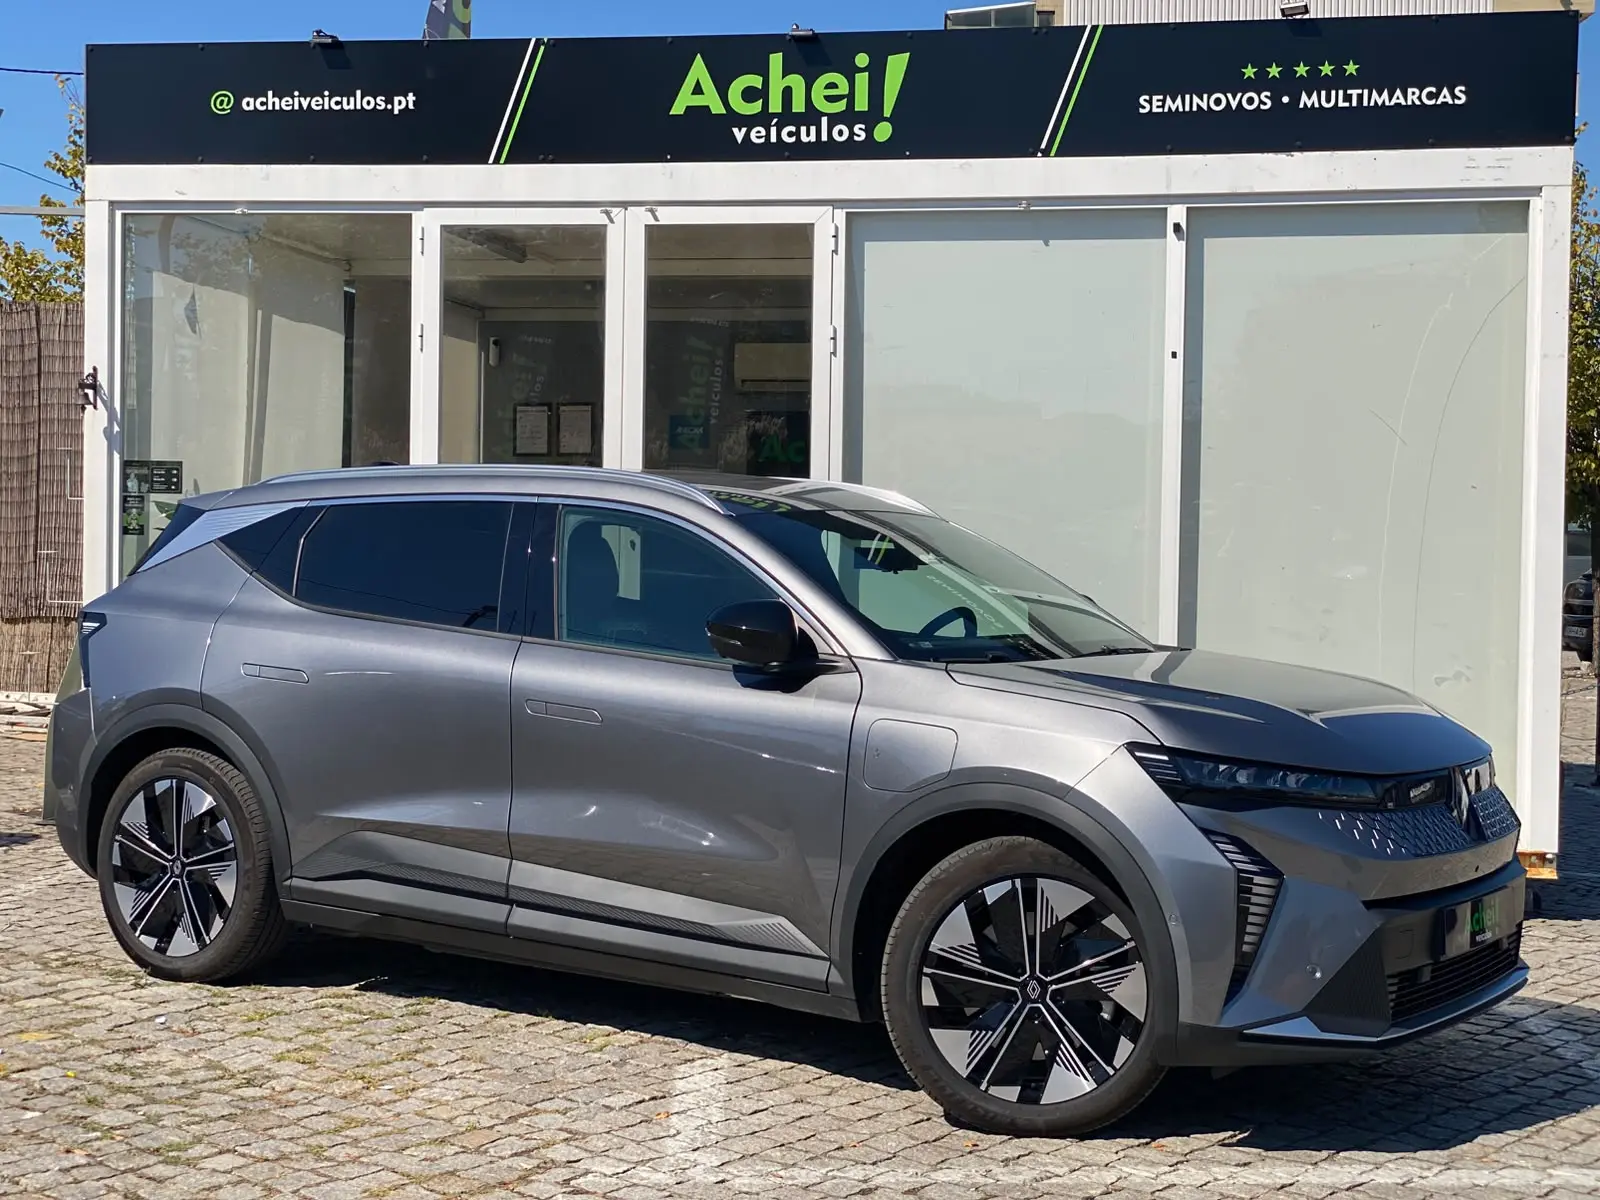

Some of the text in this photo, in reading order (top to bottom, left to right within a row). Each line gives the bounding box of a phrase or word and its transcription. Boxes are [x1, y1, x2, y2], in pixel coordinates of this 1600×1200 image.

[210, 90, 417, 115] @ acheiveiculos.pt
[669, 52, 911, 143] Achei!
[1138, 84, 1467, 114] SEMINOVOS MULTIMARCAS
[731, 116, 867, 145] veículos
